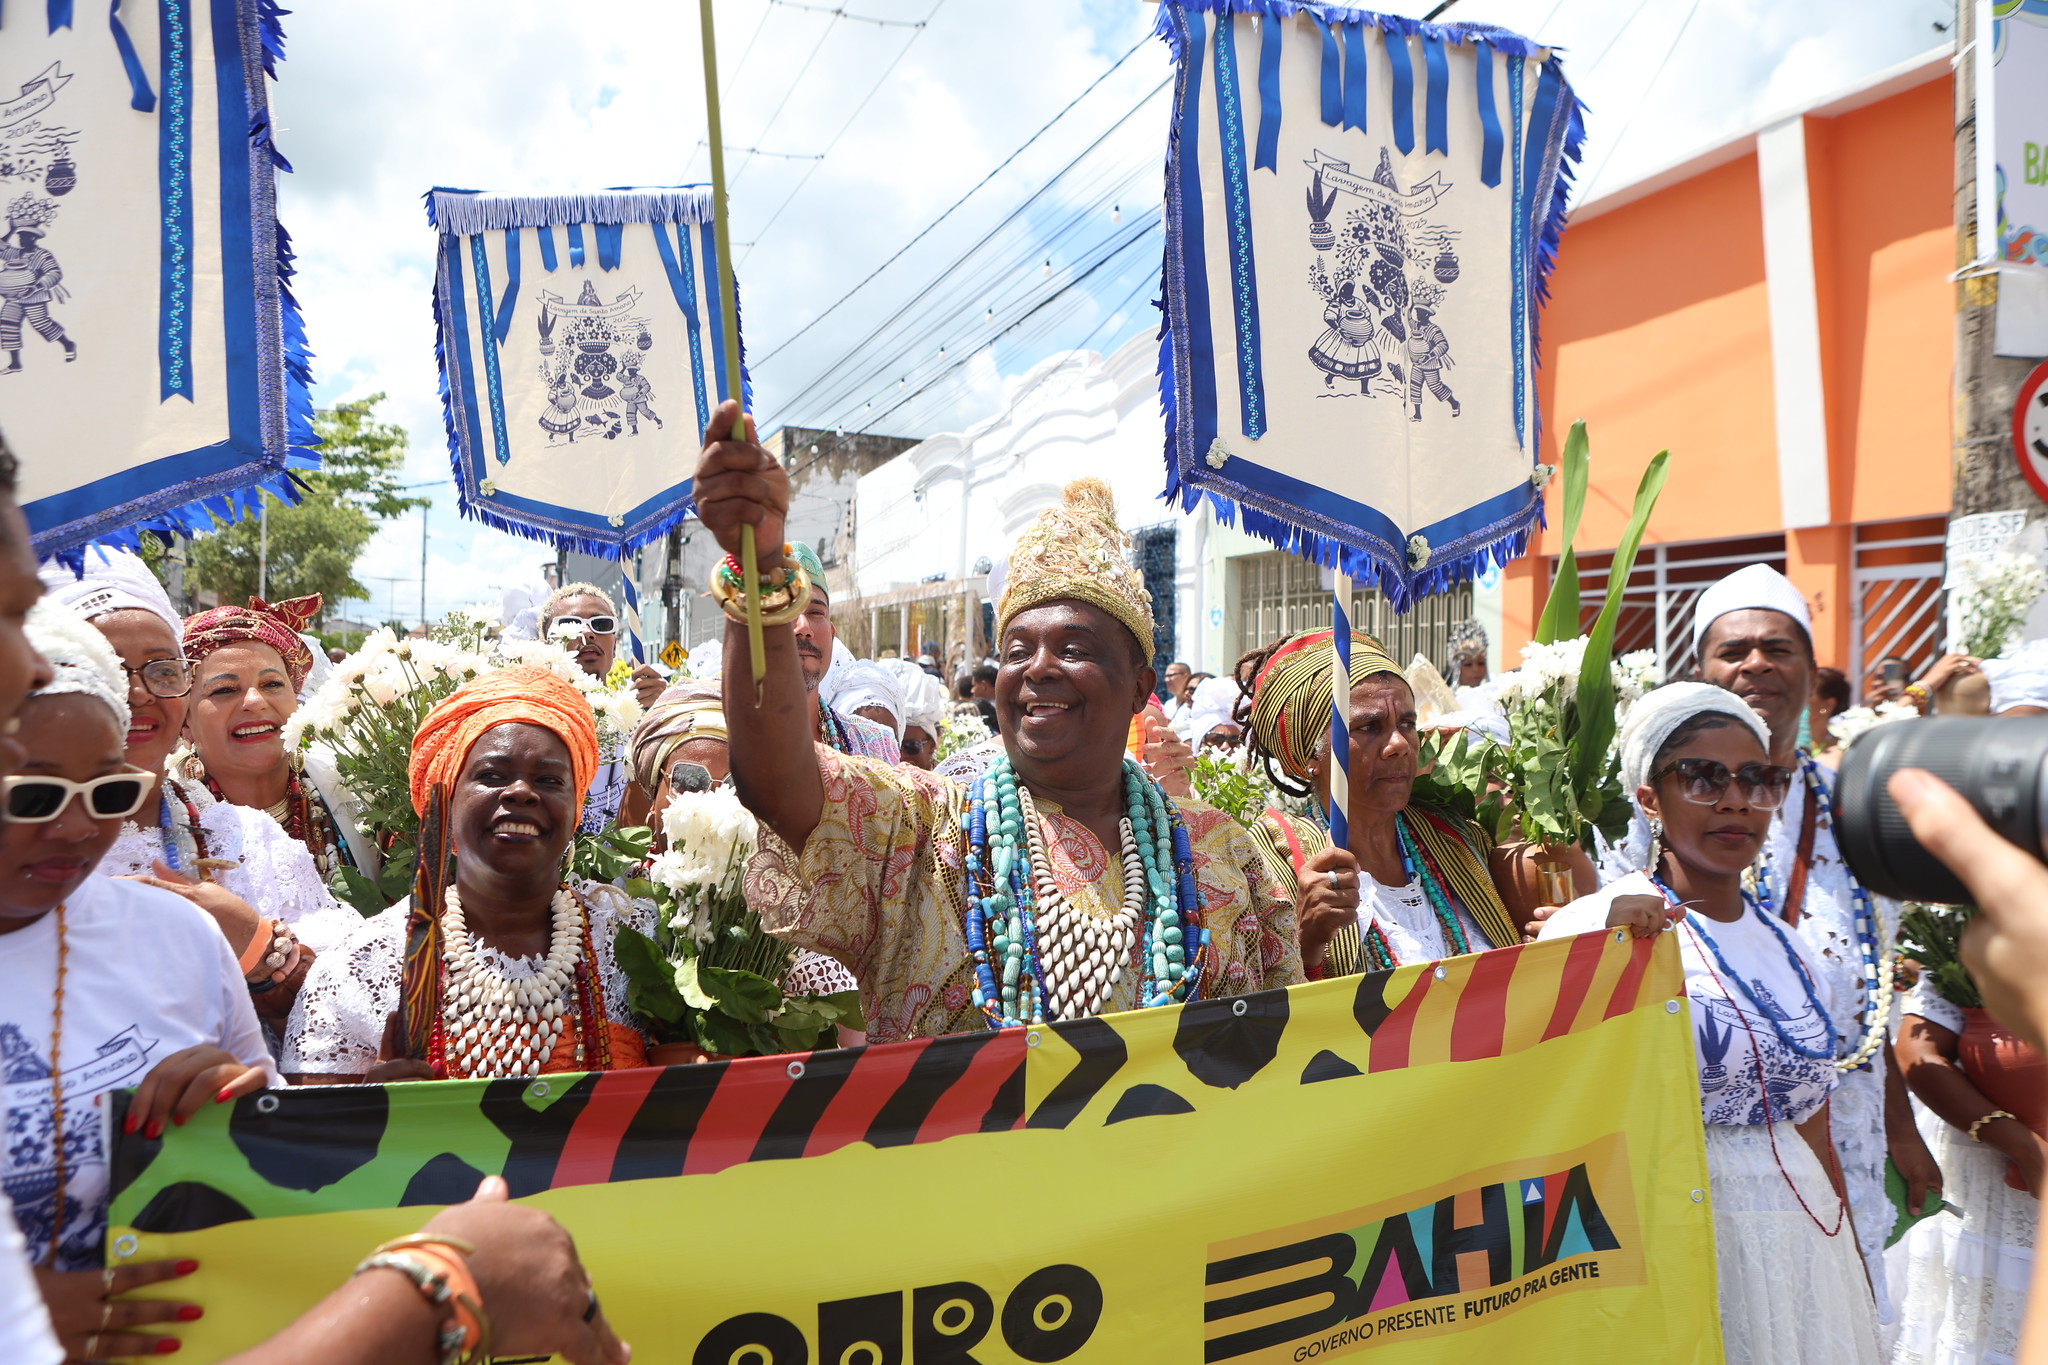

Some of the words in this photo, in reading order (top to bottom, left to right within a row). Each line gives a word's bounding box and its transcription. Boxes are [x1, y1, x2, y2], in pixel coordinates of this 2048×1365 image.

[4, 93, 48, 118] Amaro
[5, 119, 41, 139] 2025
[1325, 171, 1375, 193] Lavagem
[1406, 217, 1428, 230] 2025
[549, 305, 578, 317] Lavagem
[609, 300, 632, 313] Amaro
[612, 314, 631, 324] 2025
[596, 790, 619, 802] Amro
[82, 1052, 138, 1083] Amaro
[1204, 1162, 1622, 1364] BAHIA
[1294, 1323, 1374, 1362] GOVERNO
[1378, 1304, 1456, 1335] PRESENTE
[1463, 1287, 1521, 1319] FUTURO
[1523, 1275, 1548, 1298] PRA
[1550, 1261, 1600, 1286] GENTE
